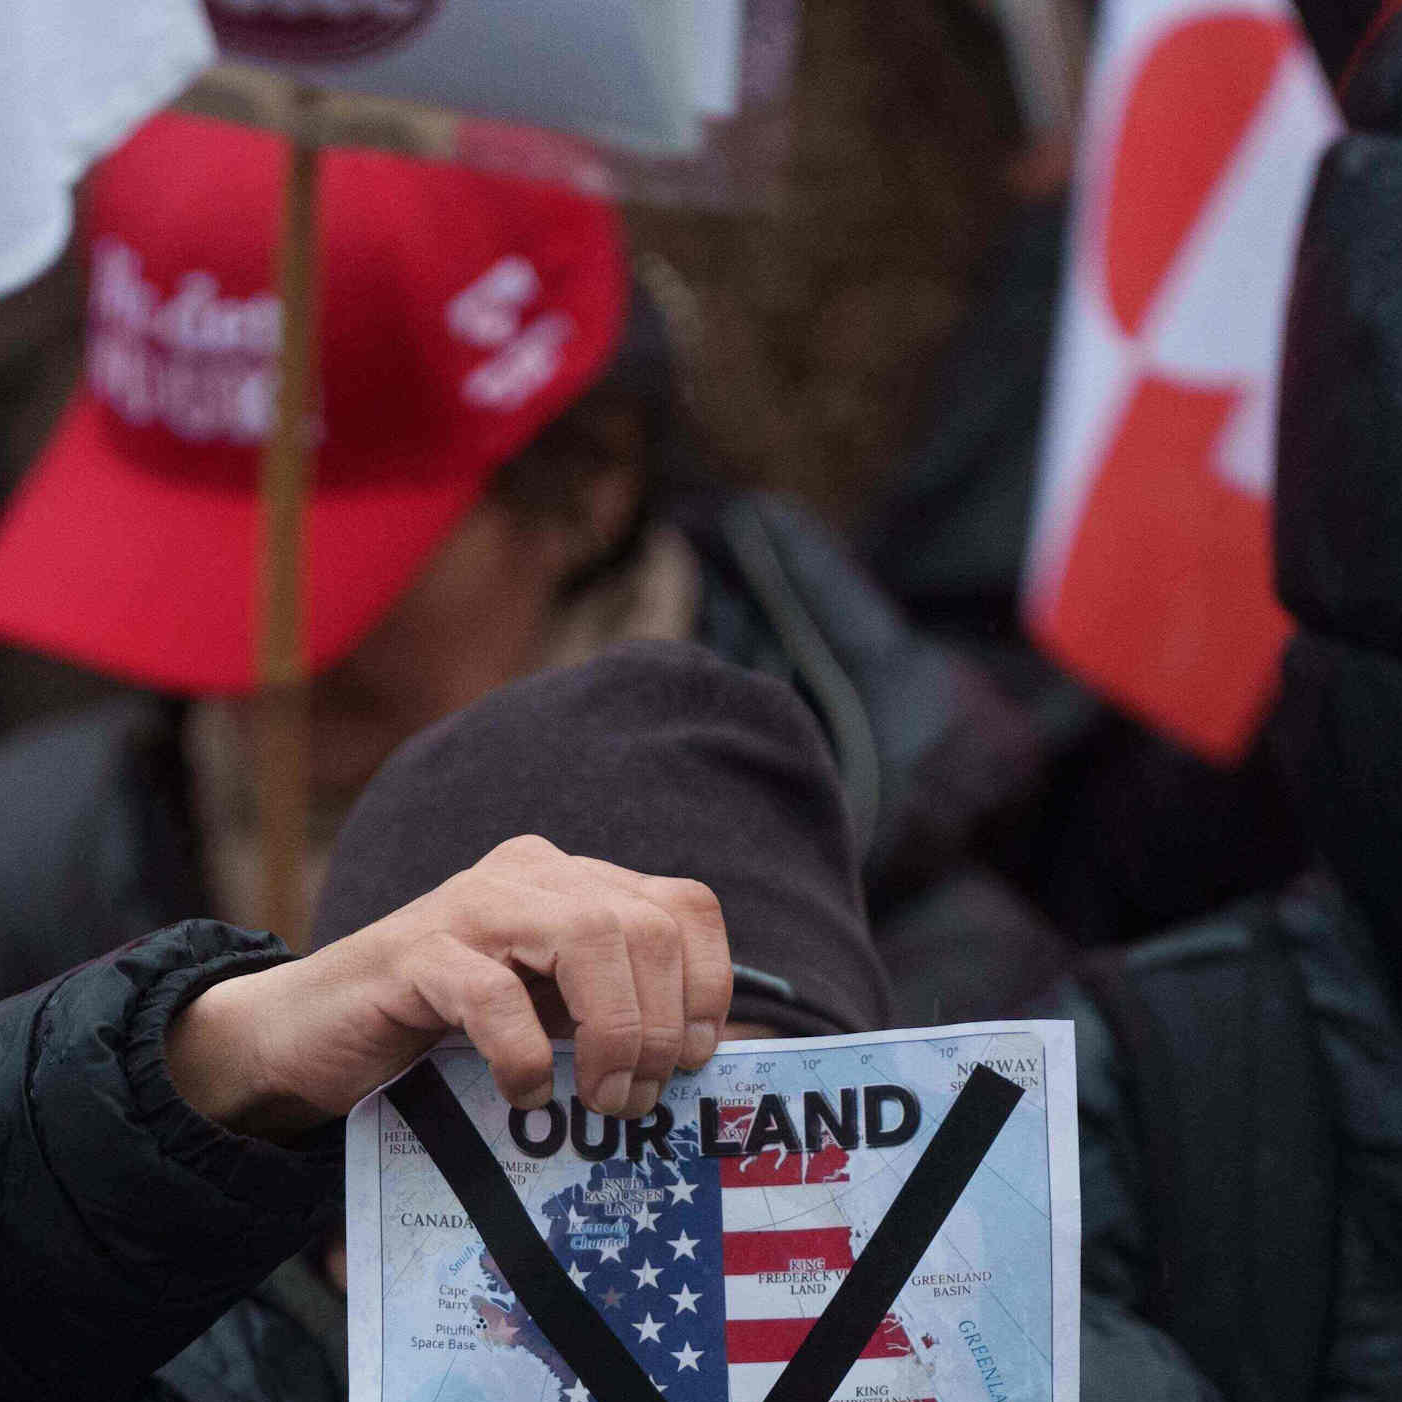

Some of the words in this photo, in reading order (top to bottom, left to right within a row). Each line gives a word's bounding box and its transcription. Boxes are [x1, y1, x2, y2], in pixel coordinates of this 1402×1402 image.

[734, 1081, 767, 1095] Cape
[508, 1094, 675, 1163] OUR
[698, 1083, 922, 1157] LAND
[758, 1270, 832, 1284] FREDERICK
[911, 1271, 992, 1287] GREENLAND
[438, 1284, 469, 1298] Cape
[790, 1283, 827, 1296] LAND
[933, 1285, 973, 1298] BASIN
[438, 1298, 469, 1313] Parry
[410, 1336, 445, 1350] Space
[448, 1339, 477, 1351] Base
[855, 1384, 889, 1397] KING
